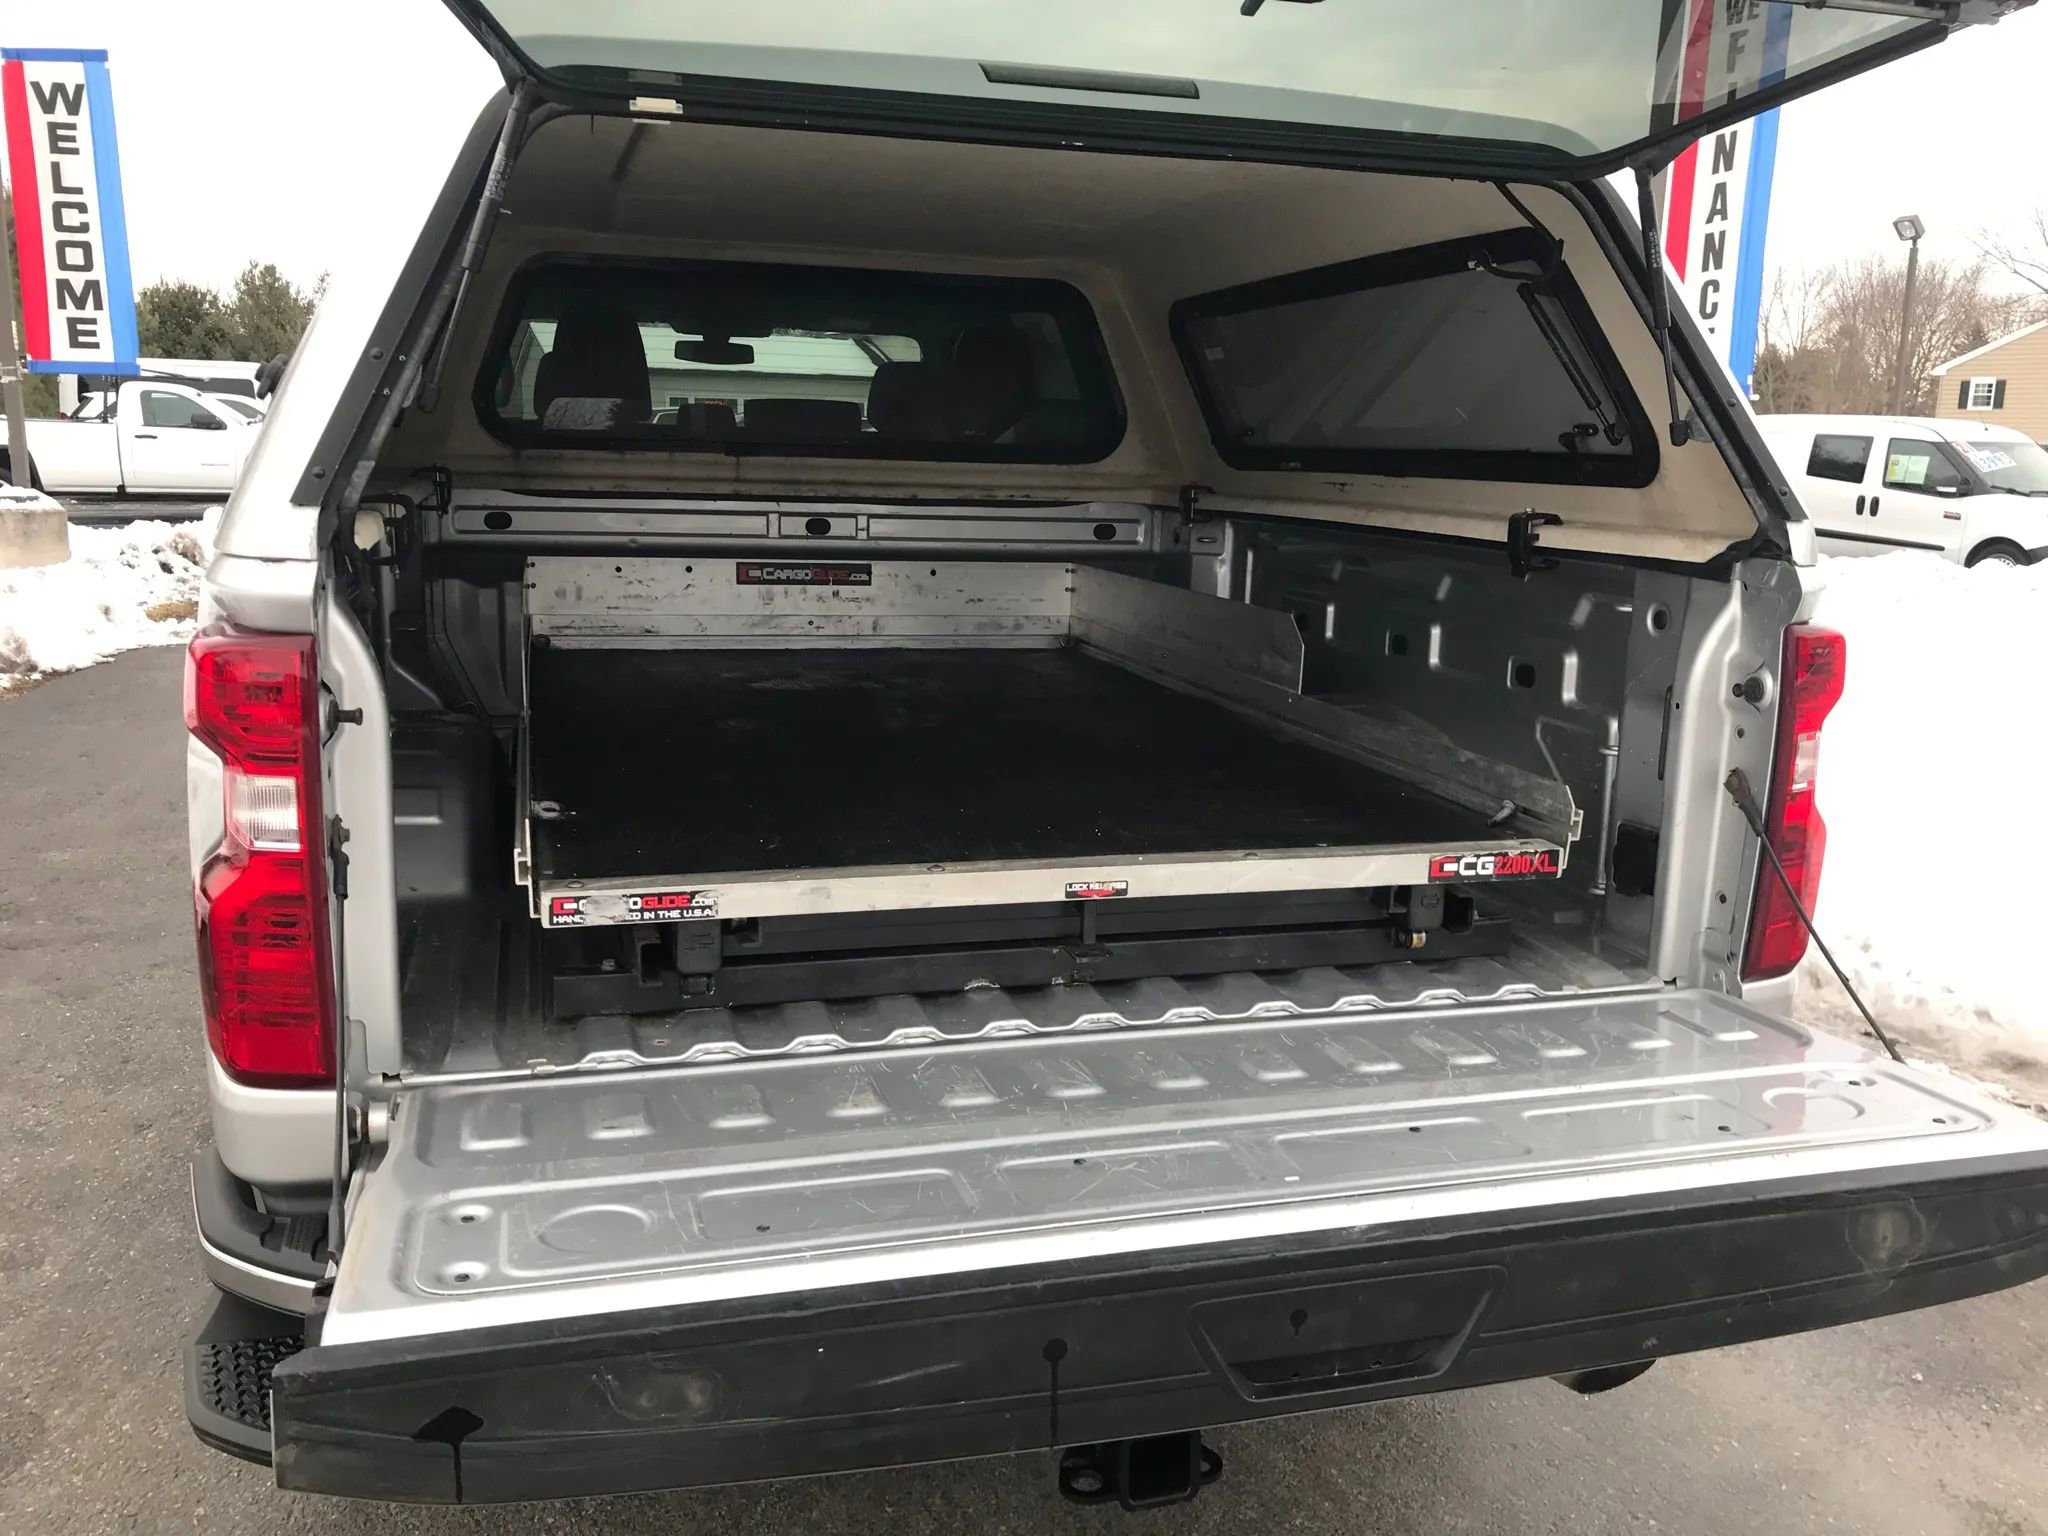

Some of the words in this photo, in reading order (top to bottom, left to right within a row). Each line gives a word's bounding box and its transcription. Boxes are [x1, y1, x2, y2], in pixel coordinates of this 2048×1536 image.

[30, 81, 103, 348] WELCOME
[1699, 28, 1749, 334] FNANC
[643, 911, 655, 919] IN
[657, 910, 681, 918] THE
[684, 908, 714, 917] U.S.A.
[1066, 883, 1088, 891] LOCK
